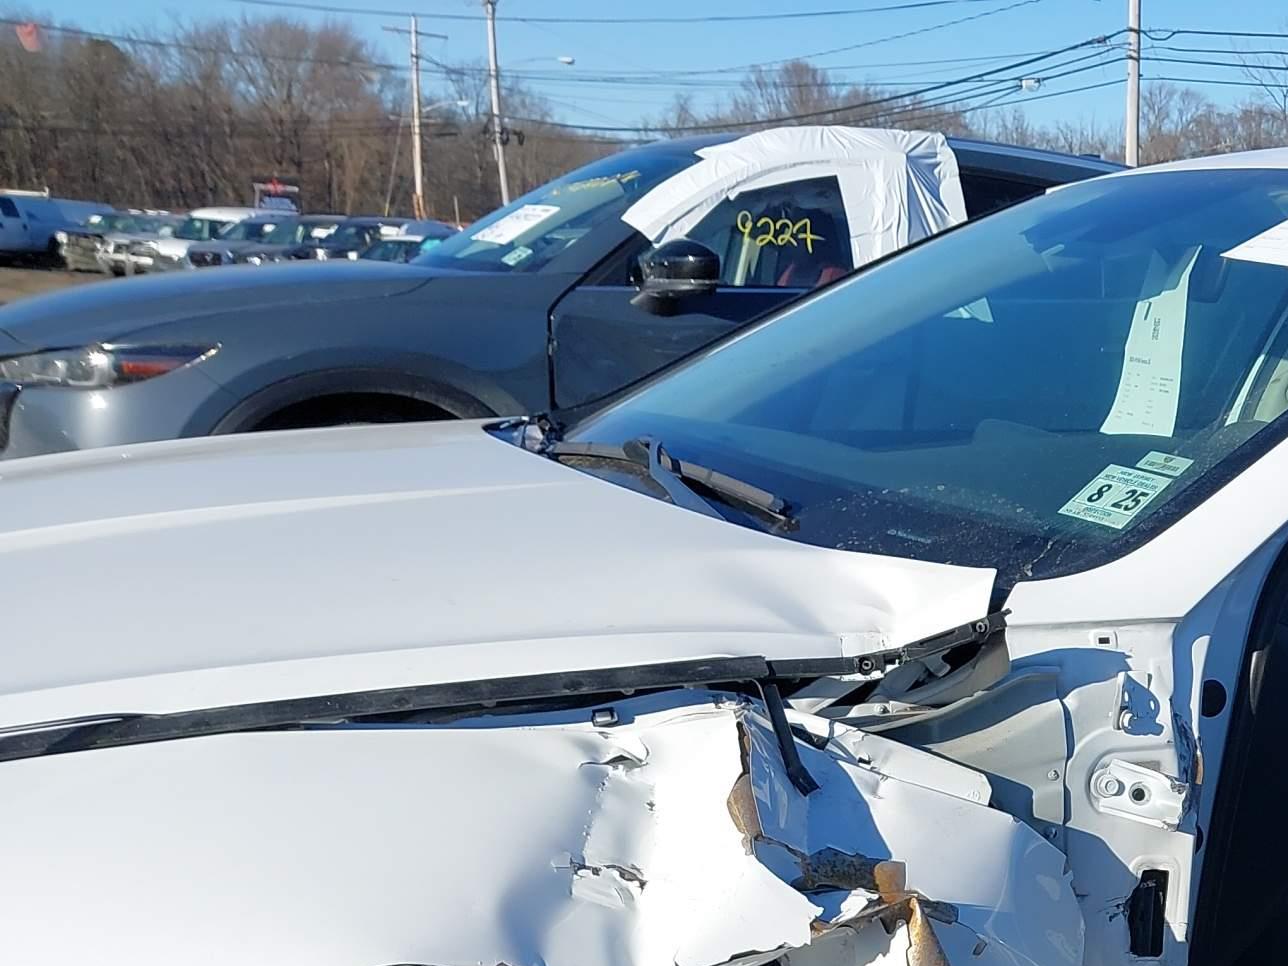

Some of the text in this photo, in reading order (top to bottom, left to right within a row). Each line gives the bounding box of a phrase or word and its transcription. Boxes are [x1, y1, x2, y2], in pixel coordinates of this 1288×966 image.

[736, 210, 825, 254] 9227
[1087, 483, 1150, 511] 8 25
